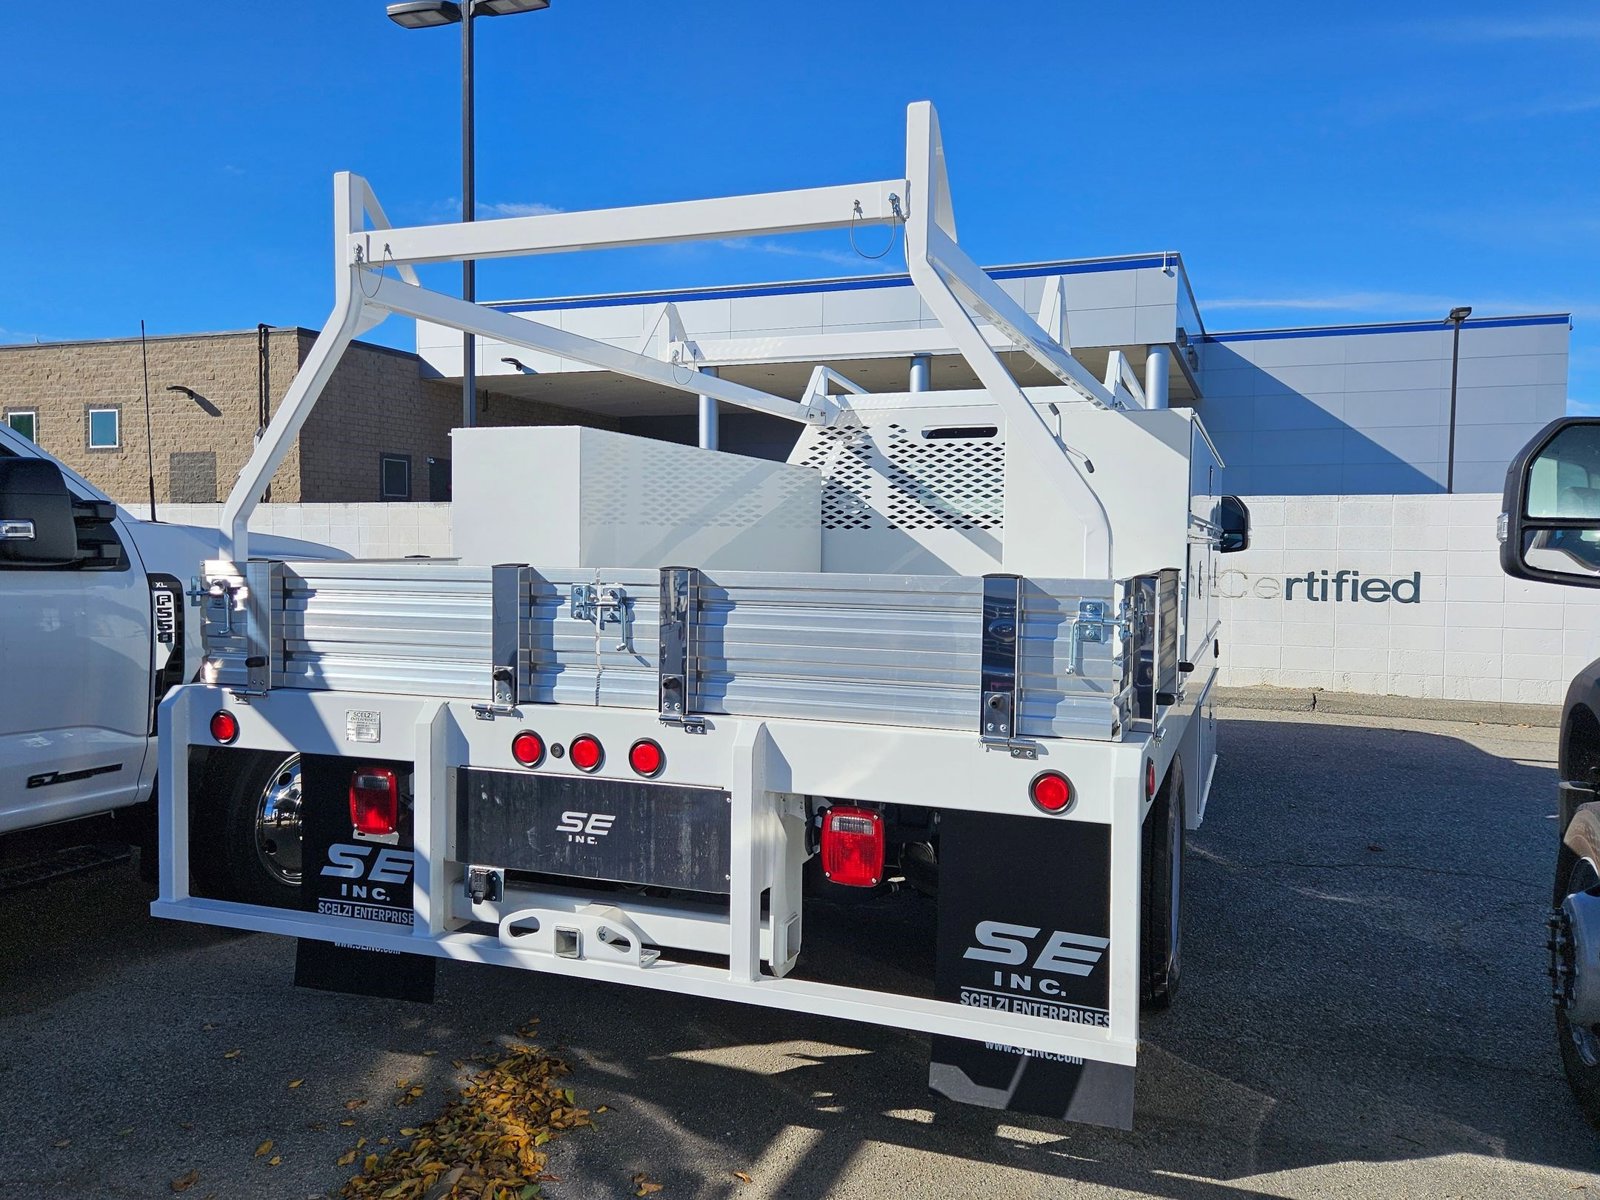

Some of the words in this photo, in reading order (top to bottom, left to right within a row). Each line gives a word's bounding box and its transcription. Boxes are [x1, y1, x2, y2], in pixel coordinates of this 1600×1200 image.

[555, 811, 616, 836] SE
[568, 834, 598, 845] INC.
[320, 843, 414, 884] SE
[341, 883, 391, 901] INC.
[318, 901, 352, 917] SCELZI
[354, 905, 414, 925] ENTERPRISE
[962, 920, 1110, 977] SE
[994, 970, 1067, 997] INC.
[960, 991, 1009, 1013] SCELZI
